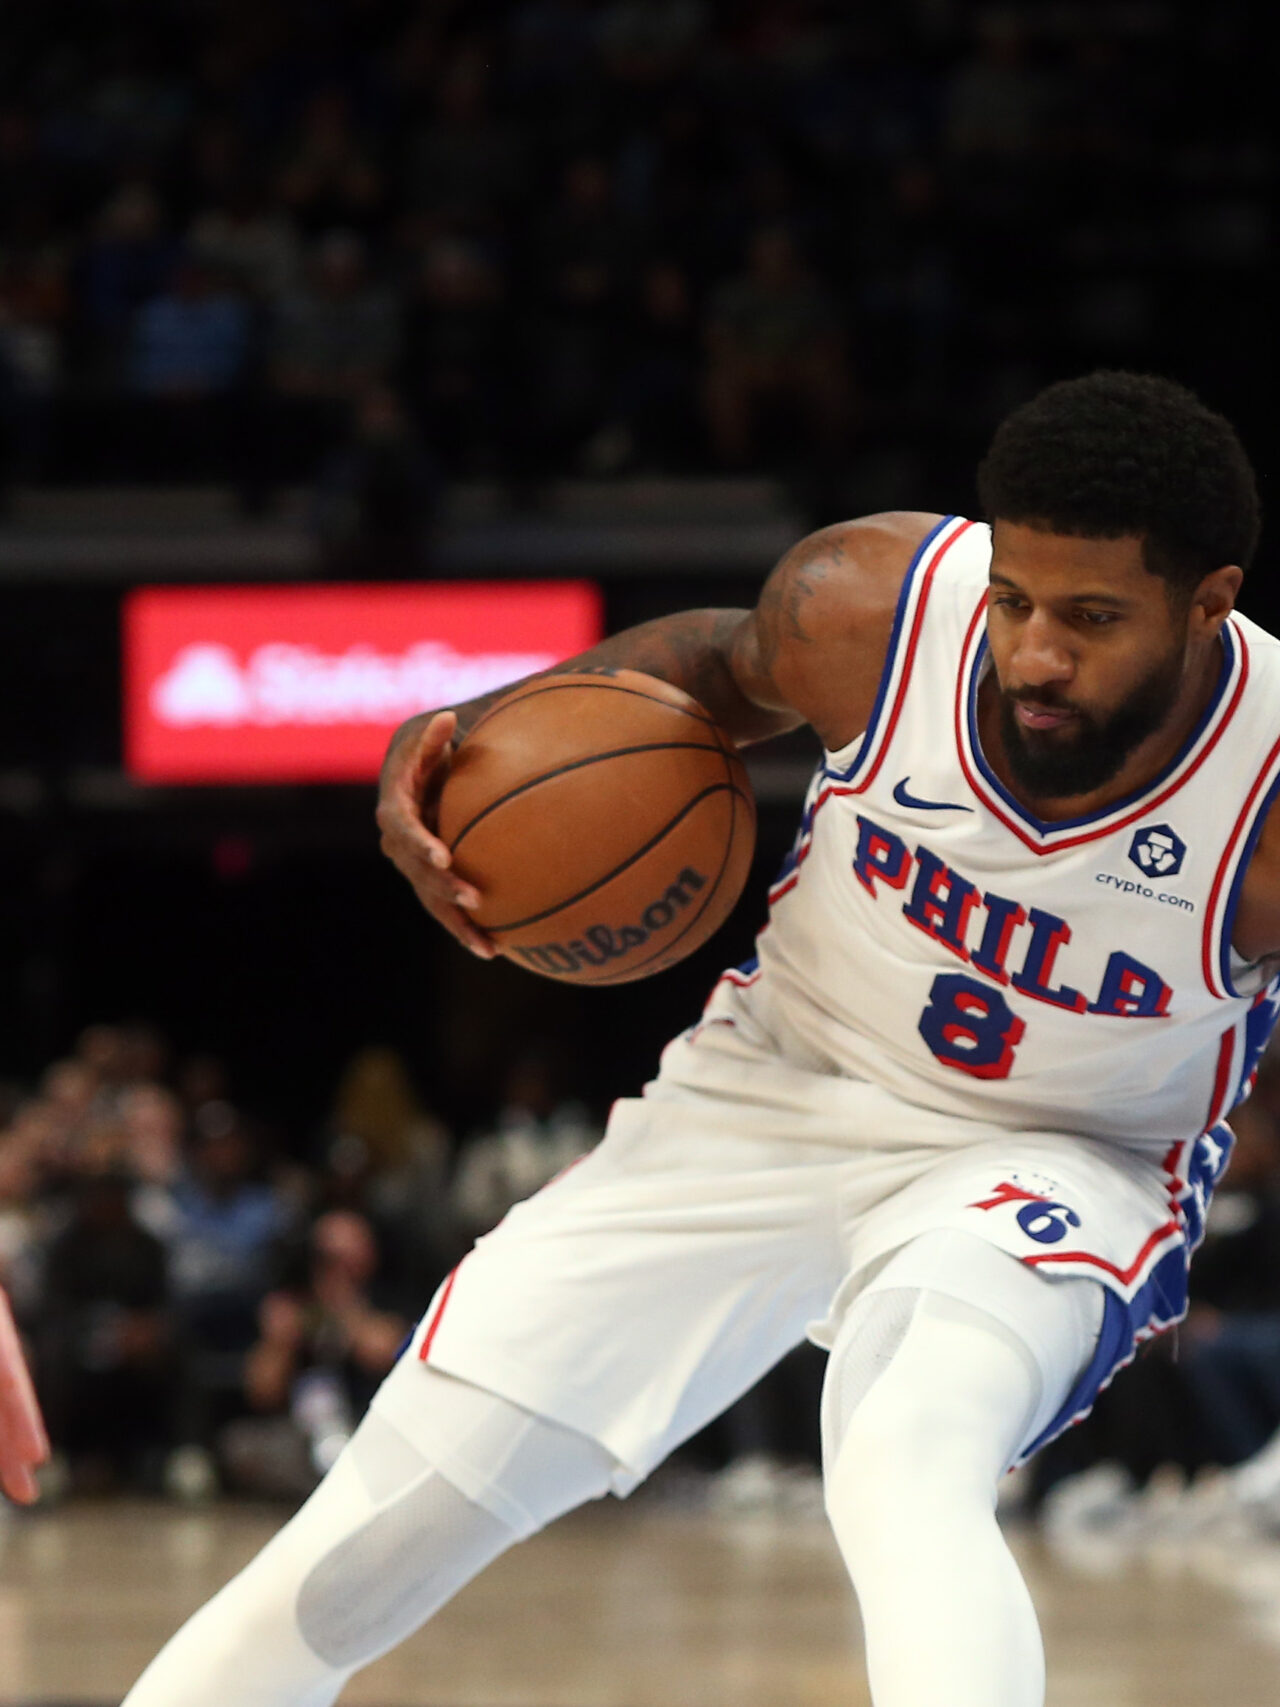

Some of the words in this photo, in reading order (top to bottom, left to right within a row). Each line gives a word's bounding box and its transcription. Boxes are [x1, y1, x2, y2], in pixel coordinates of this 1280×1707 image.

[511, 867, 708, 974] Wilson
[853, 815, 1174, 1018] PHILA
[1095, 873, 1195, 912] crypto.com
[918, 973, 1027, 1080] 8
[964, 1181, 1081, 1244] 76
